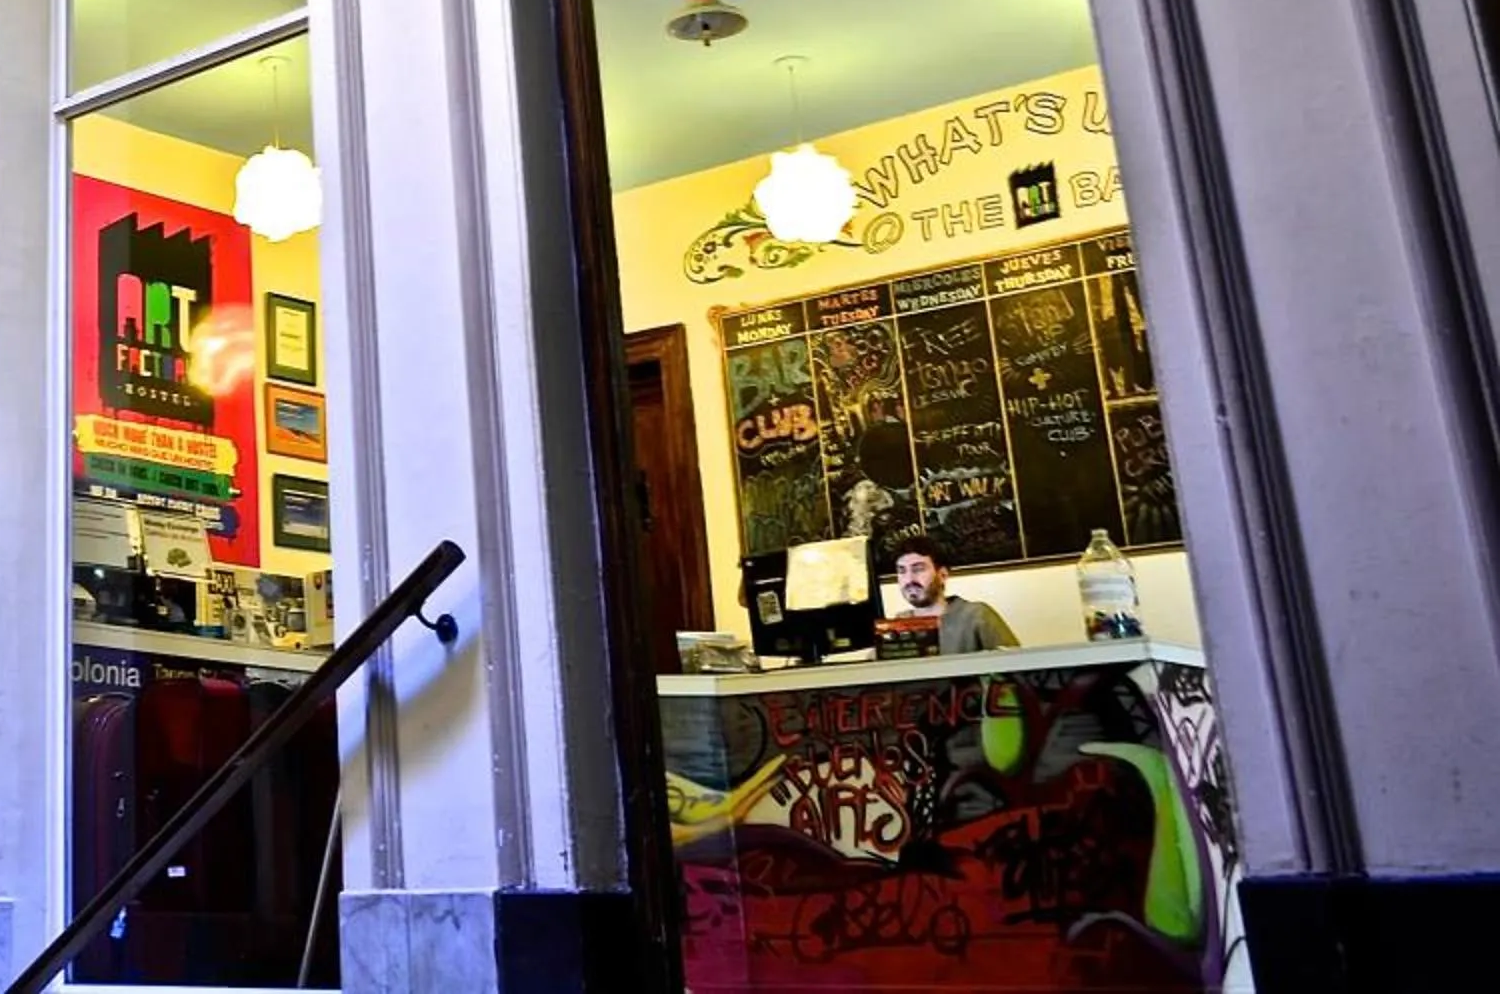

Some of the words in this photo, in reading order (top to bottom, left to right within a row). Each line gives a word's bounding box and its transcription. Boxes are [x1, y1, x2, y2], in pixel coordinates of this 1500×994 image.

[852, 92, 1066, 209] WHAT'S
[911, 193, 1004, 243] THE
[1000, 249, 1062, 274] JUEVES
[996, 264, 1072, 293] THURSDAY
[818, 289, 878, 310] MARTES
[897, 284, 981, 312] WEDNESDAY
[117, 273, 197, 353] ART
[740, 310, 782, 327] LUNES
[821, 305, 878, 326] TUESDAY
[736, 322, 792, 344] MONDAY
[902, 318, 982, 358] FREE
[116, 343, 190, 383] FACTOR
[124, 383, 192, 406] HOSTEL
[737, 403, 820, 450] CLUB
[71, 656, 141, 688] olonia
